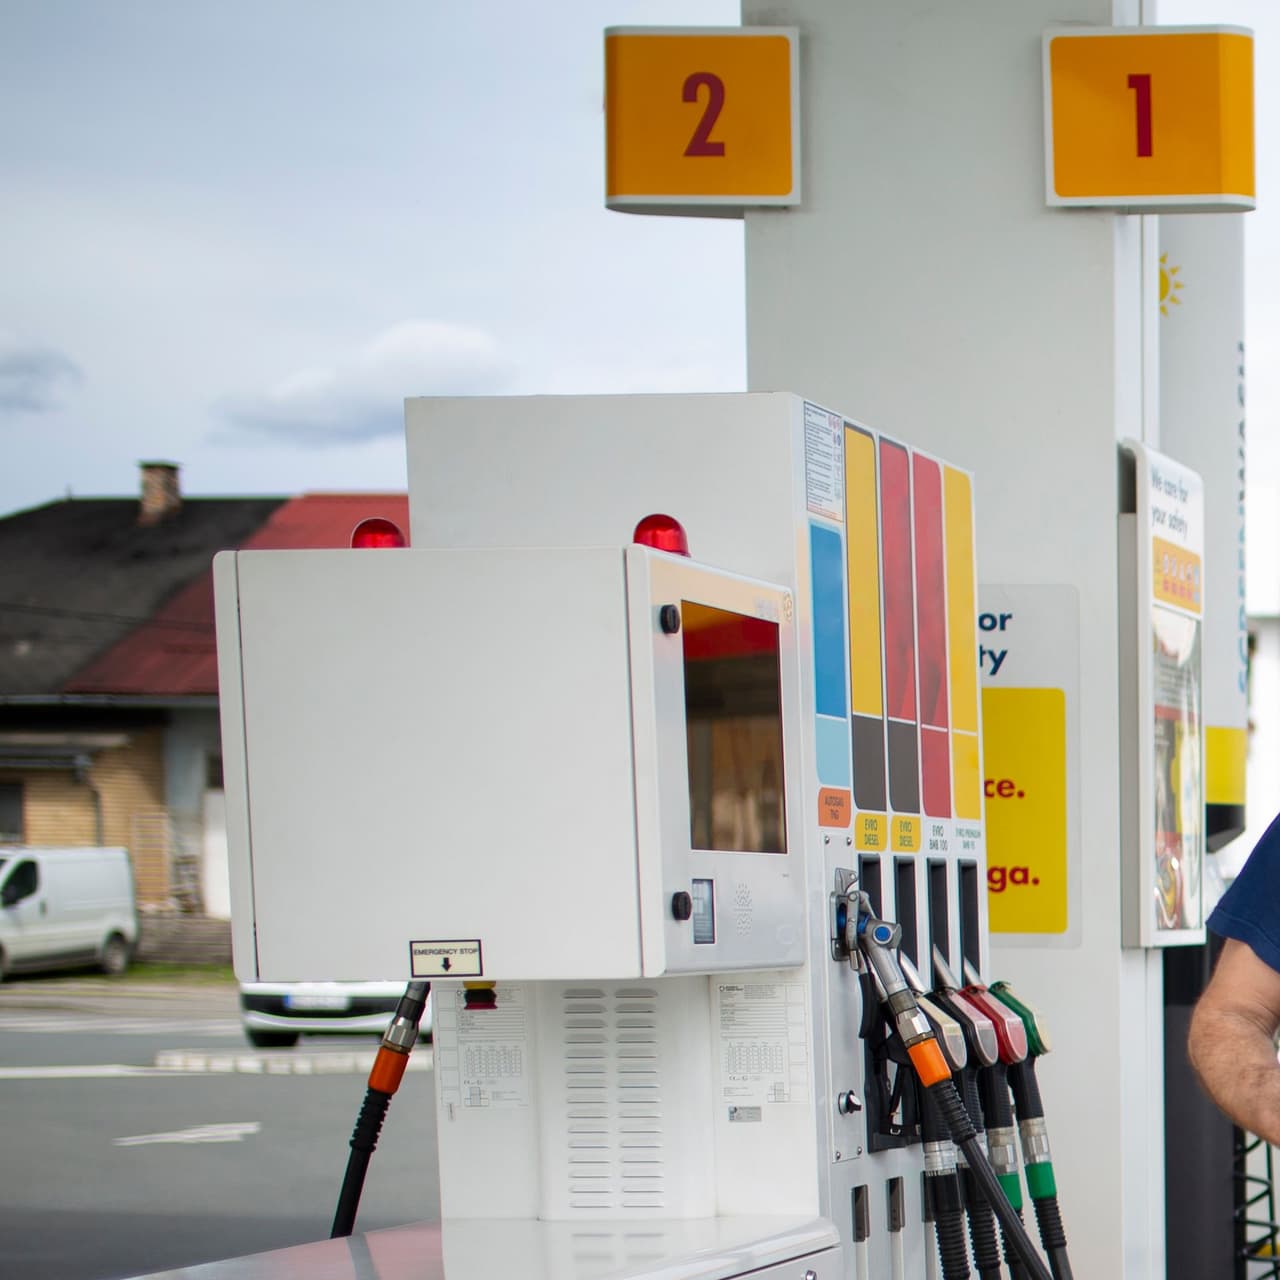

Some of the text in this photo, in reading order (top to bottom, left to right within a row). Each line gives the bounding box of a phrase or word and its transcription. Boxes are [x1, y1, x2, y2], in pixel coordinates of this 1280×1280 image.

[680, 71, 726, 157] 2
[1127, 74, 1153, 157] 1
[978, 613, 1012, 631] or
[864, 833, 879, 846] DIESEL
[899, 835, 914, 847] DIESEL
[987, 867, 1040, 893] ga.
[414, 947, 478, 956] EMERGENCY STOP
